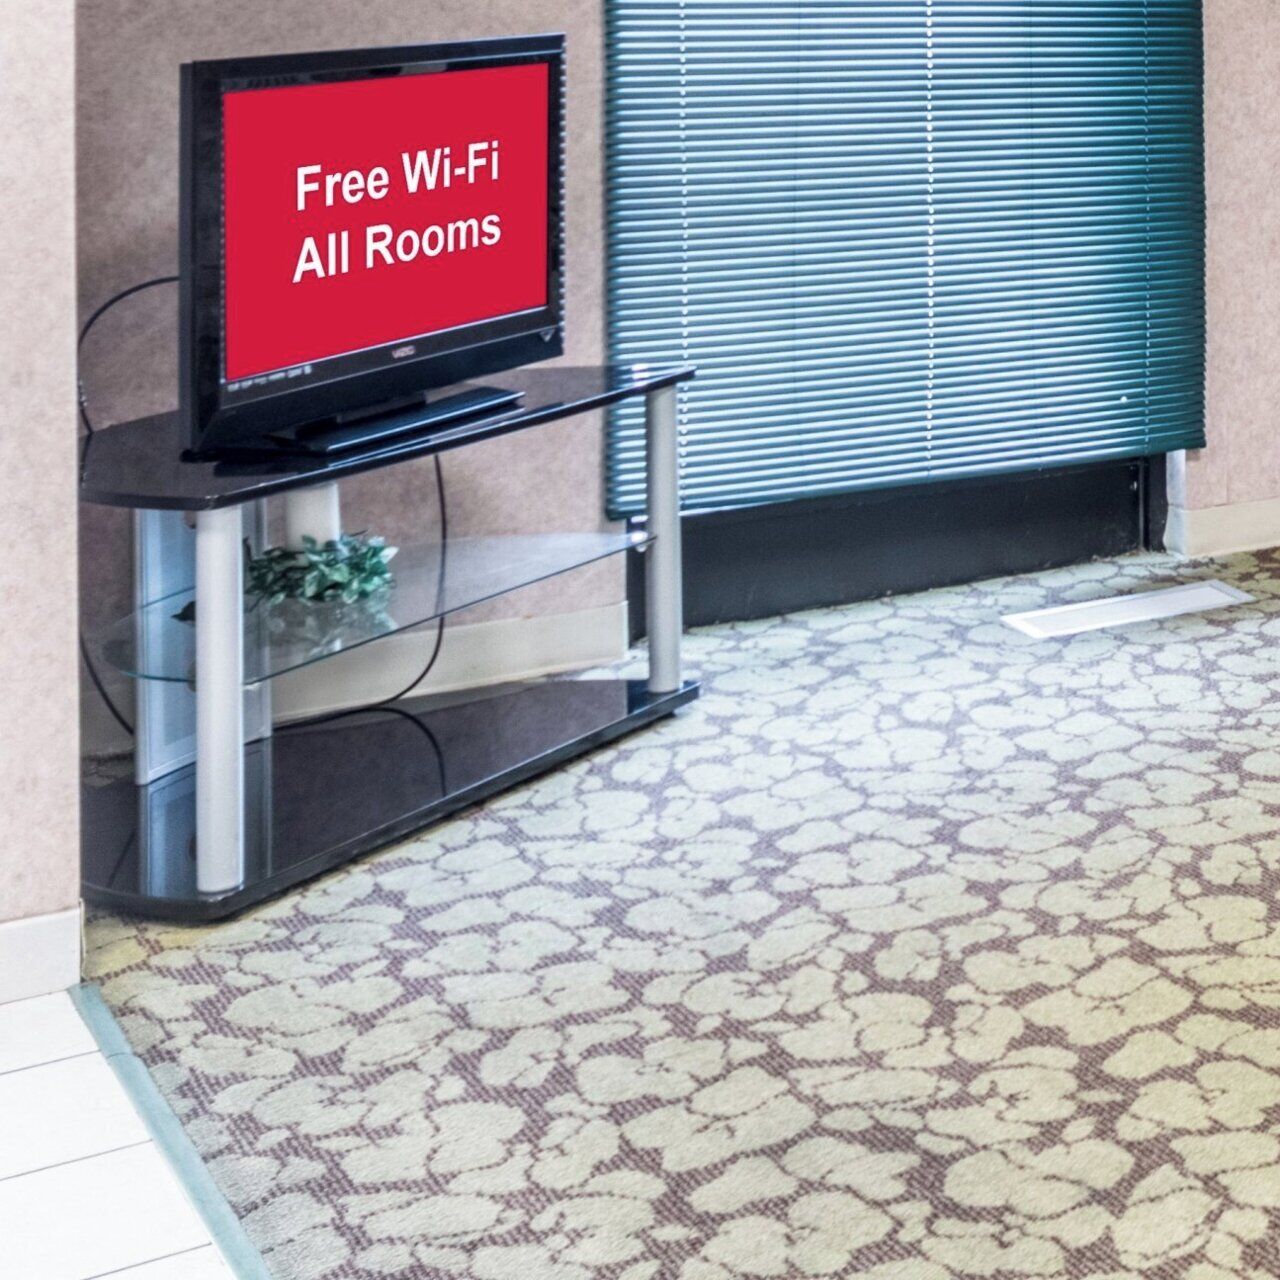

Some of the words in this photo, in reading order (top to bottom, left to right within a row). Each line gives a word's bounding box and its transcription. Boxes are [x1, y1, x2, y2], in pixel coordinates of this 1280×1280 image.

[292, 165, 389, 211] Free
[401, 140, 499, 193] Wi-Fi
[292, 229, 349, 283] All
[365, 215, 502, 270] Rooms
